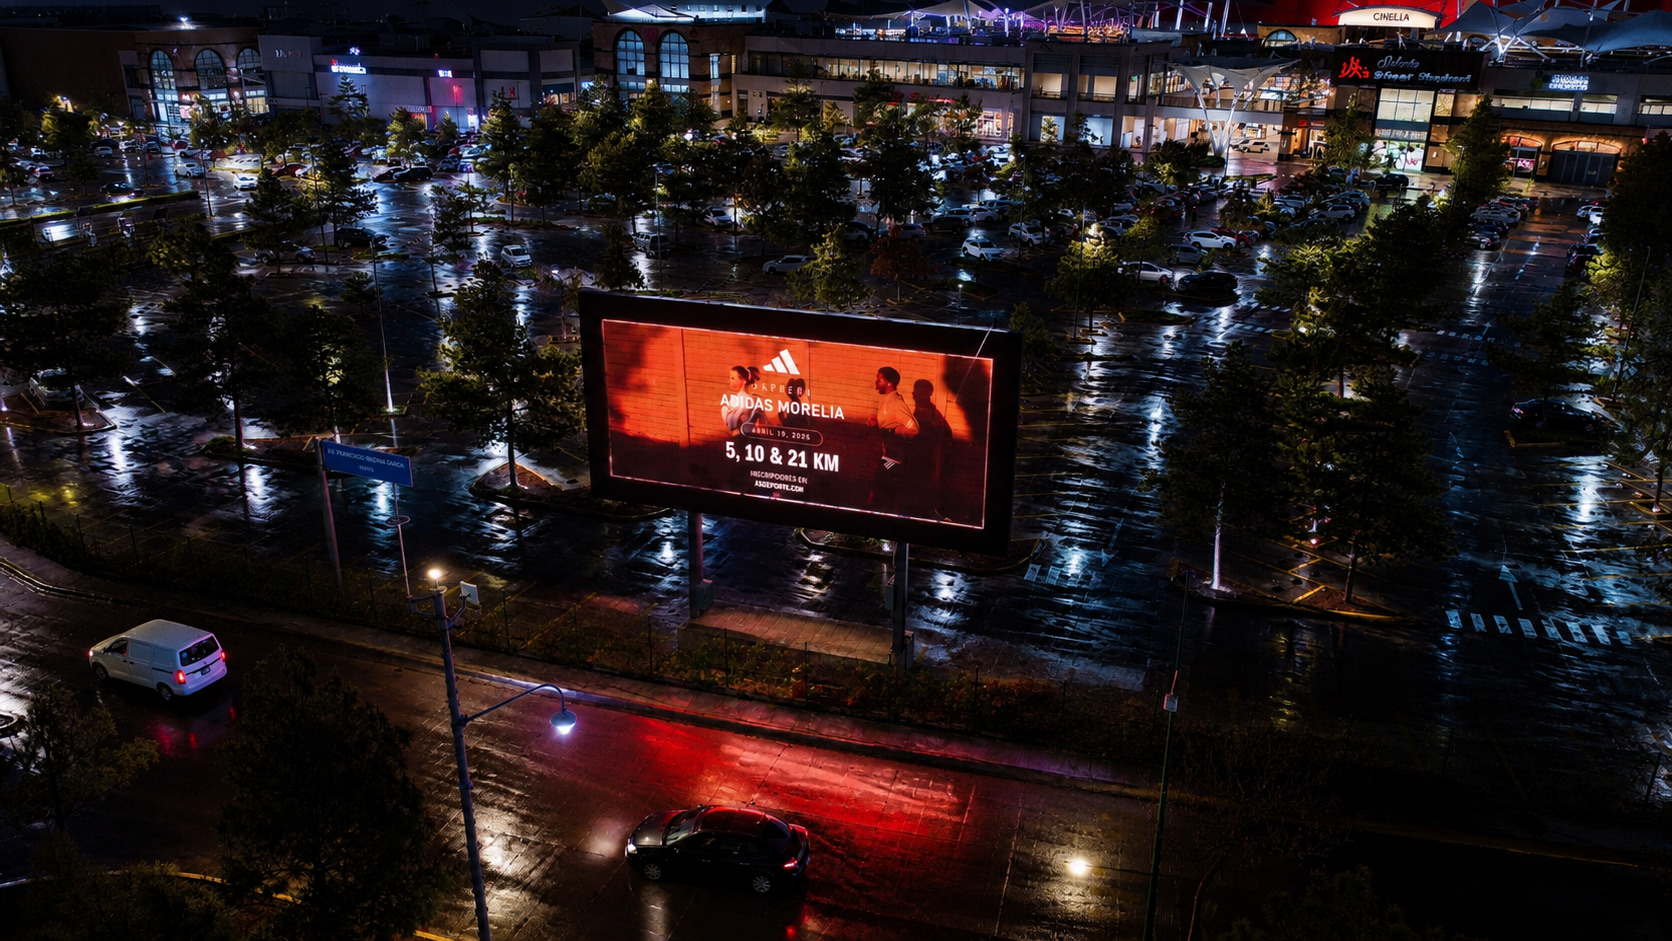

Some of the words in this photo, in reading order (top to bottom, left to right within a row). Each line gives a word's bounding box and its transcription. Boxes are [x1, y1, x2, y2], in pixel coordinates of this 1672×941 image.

[720, 393, 773, 412] ADIDAS
[778, 400, 845, 419] MORELIA
[792, 432, 811, 440] 2026
[725, 441, 740, 462] 5,
[745, 443, 765, 462] 10
[770, 447, 782, 465] &
[788, 449, 808, 468] 21
[813, 452, 839, 472] KM
